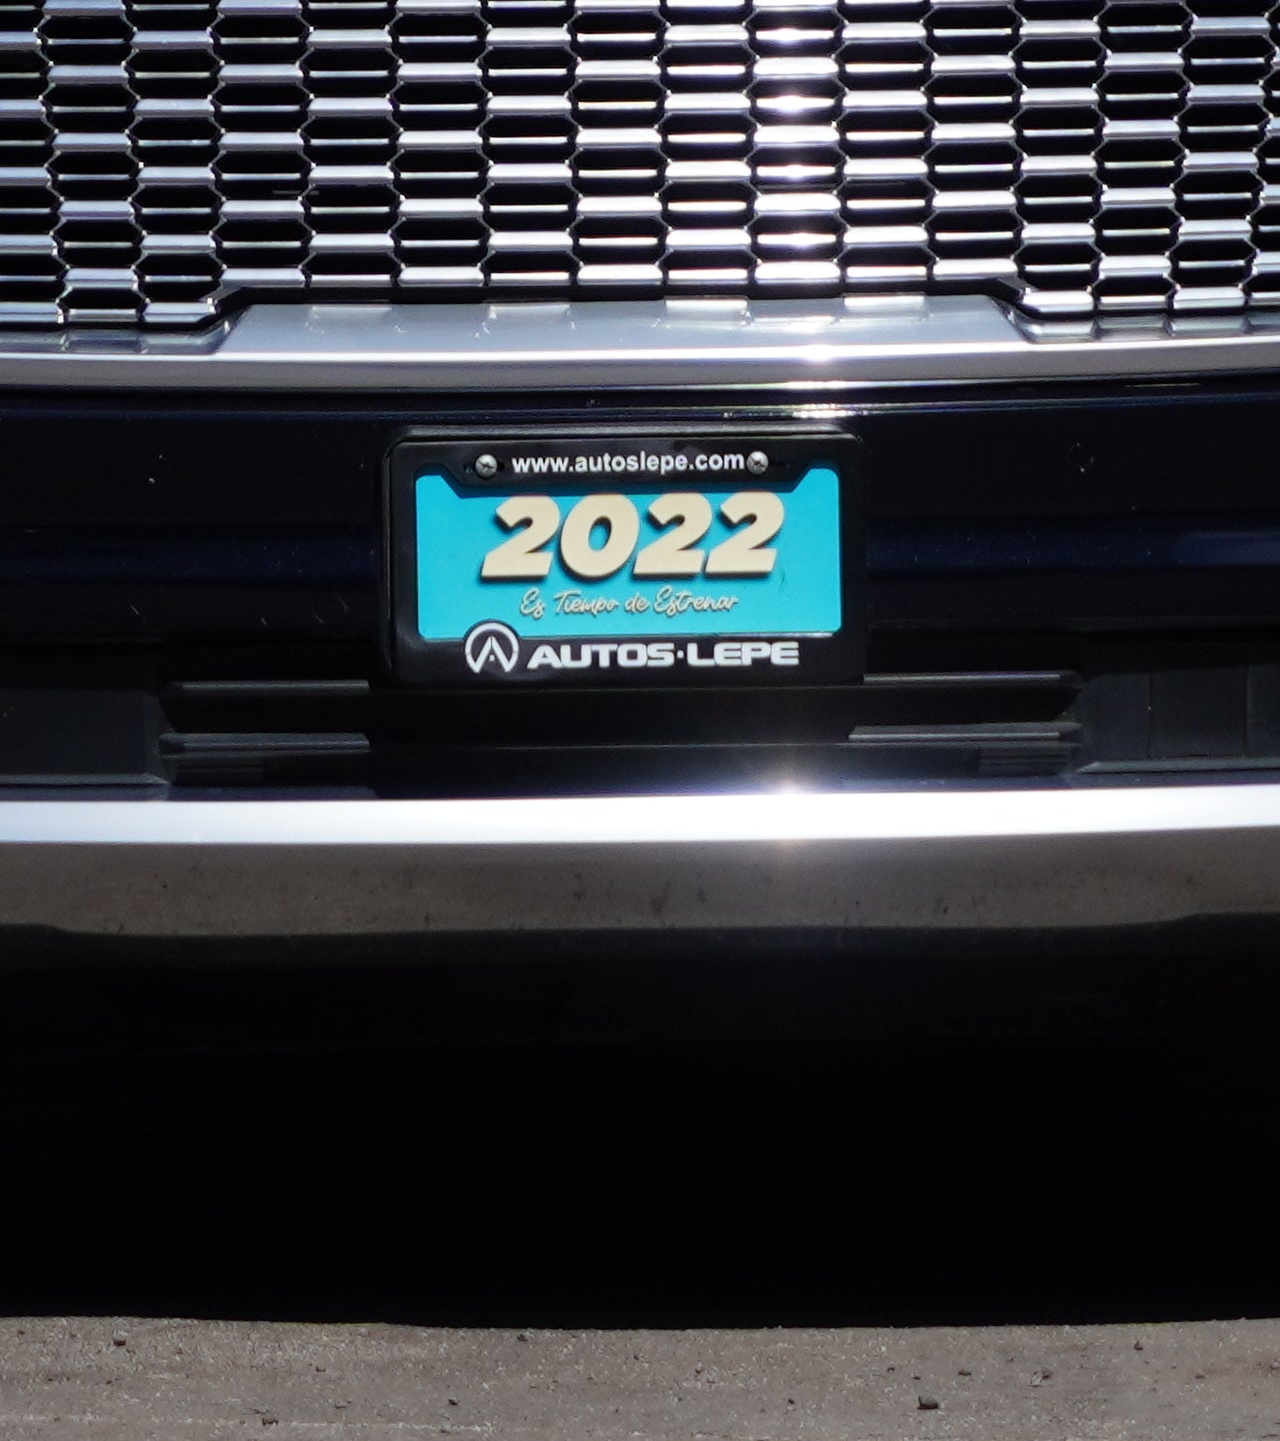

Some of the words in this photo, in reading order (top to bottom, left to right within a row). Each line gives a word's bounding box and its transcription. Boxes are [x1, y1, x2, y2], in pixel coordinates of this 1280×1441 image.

[511, 451, 744, 474] www.autoslepe.com
[481, 492, 784, 578] 2022
[520, 587, 545, 619] Es
[555, 589, 620, 617] Tiempo
[624, 590, 649, 612] de
[653, 585, 738, 617] Estrenar
